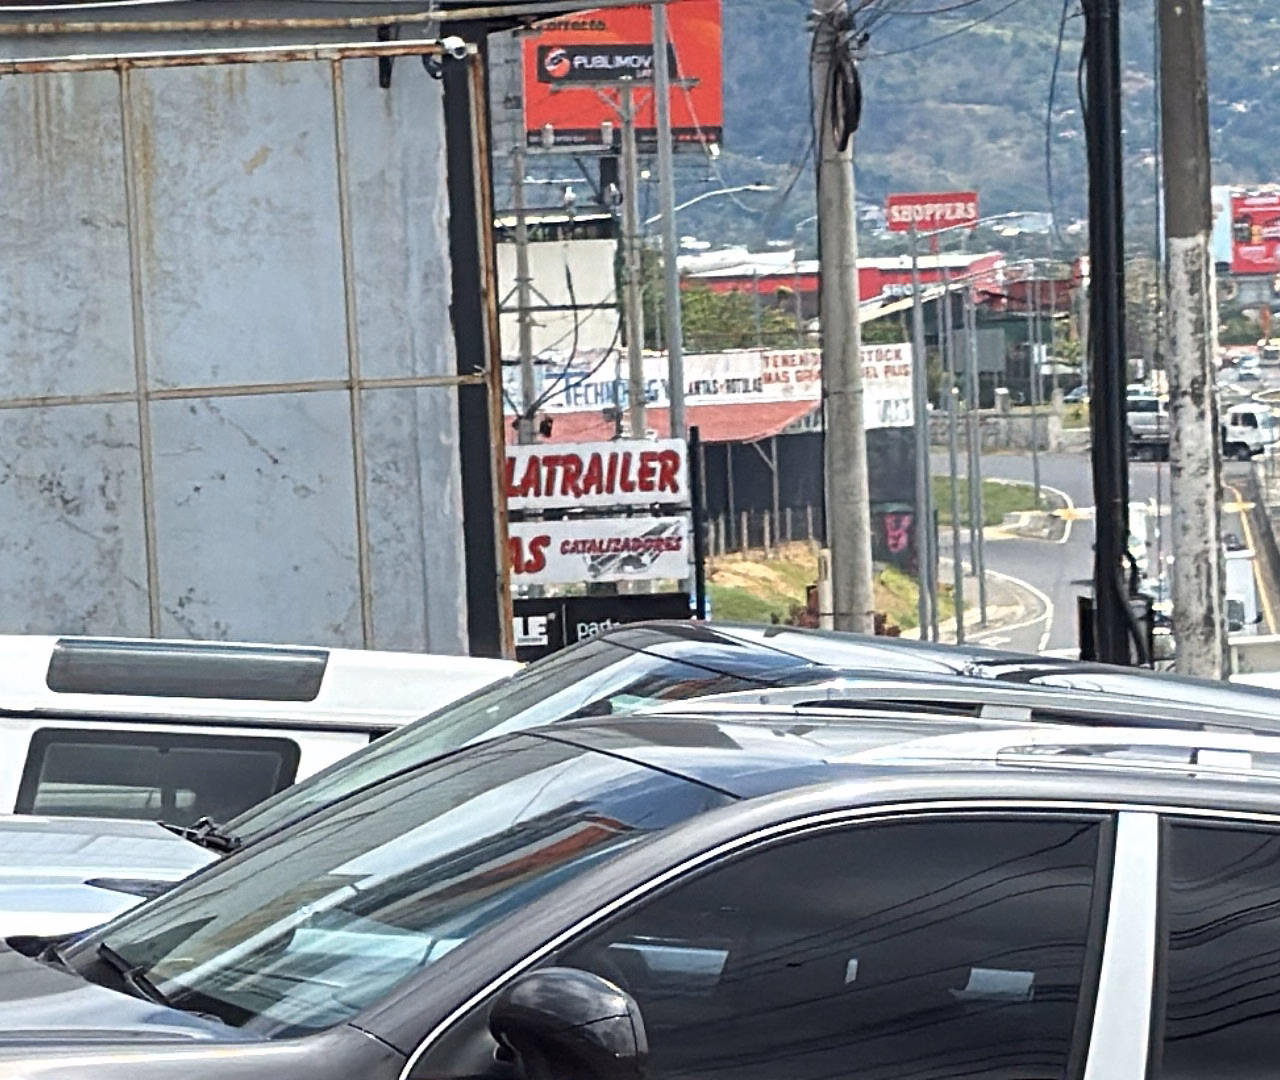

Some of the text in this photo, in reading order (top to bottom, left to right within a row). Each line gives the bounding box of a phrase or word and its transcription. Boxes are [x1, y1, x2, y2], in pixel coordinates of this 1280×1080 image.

[573, 55, 652, 69] PUBLIMOV
[890, 202, 977, 222] SHOPPERS
[763, 352, 821, 368] TENEMO
[560, 536, 683, 555] CATALIZADORES
